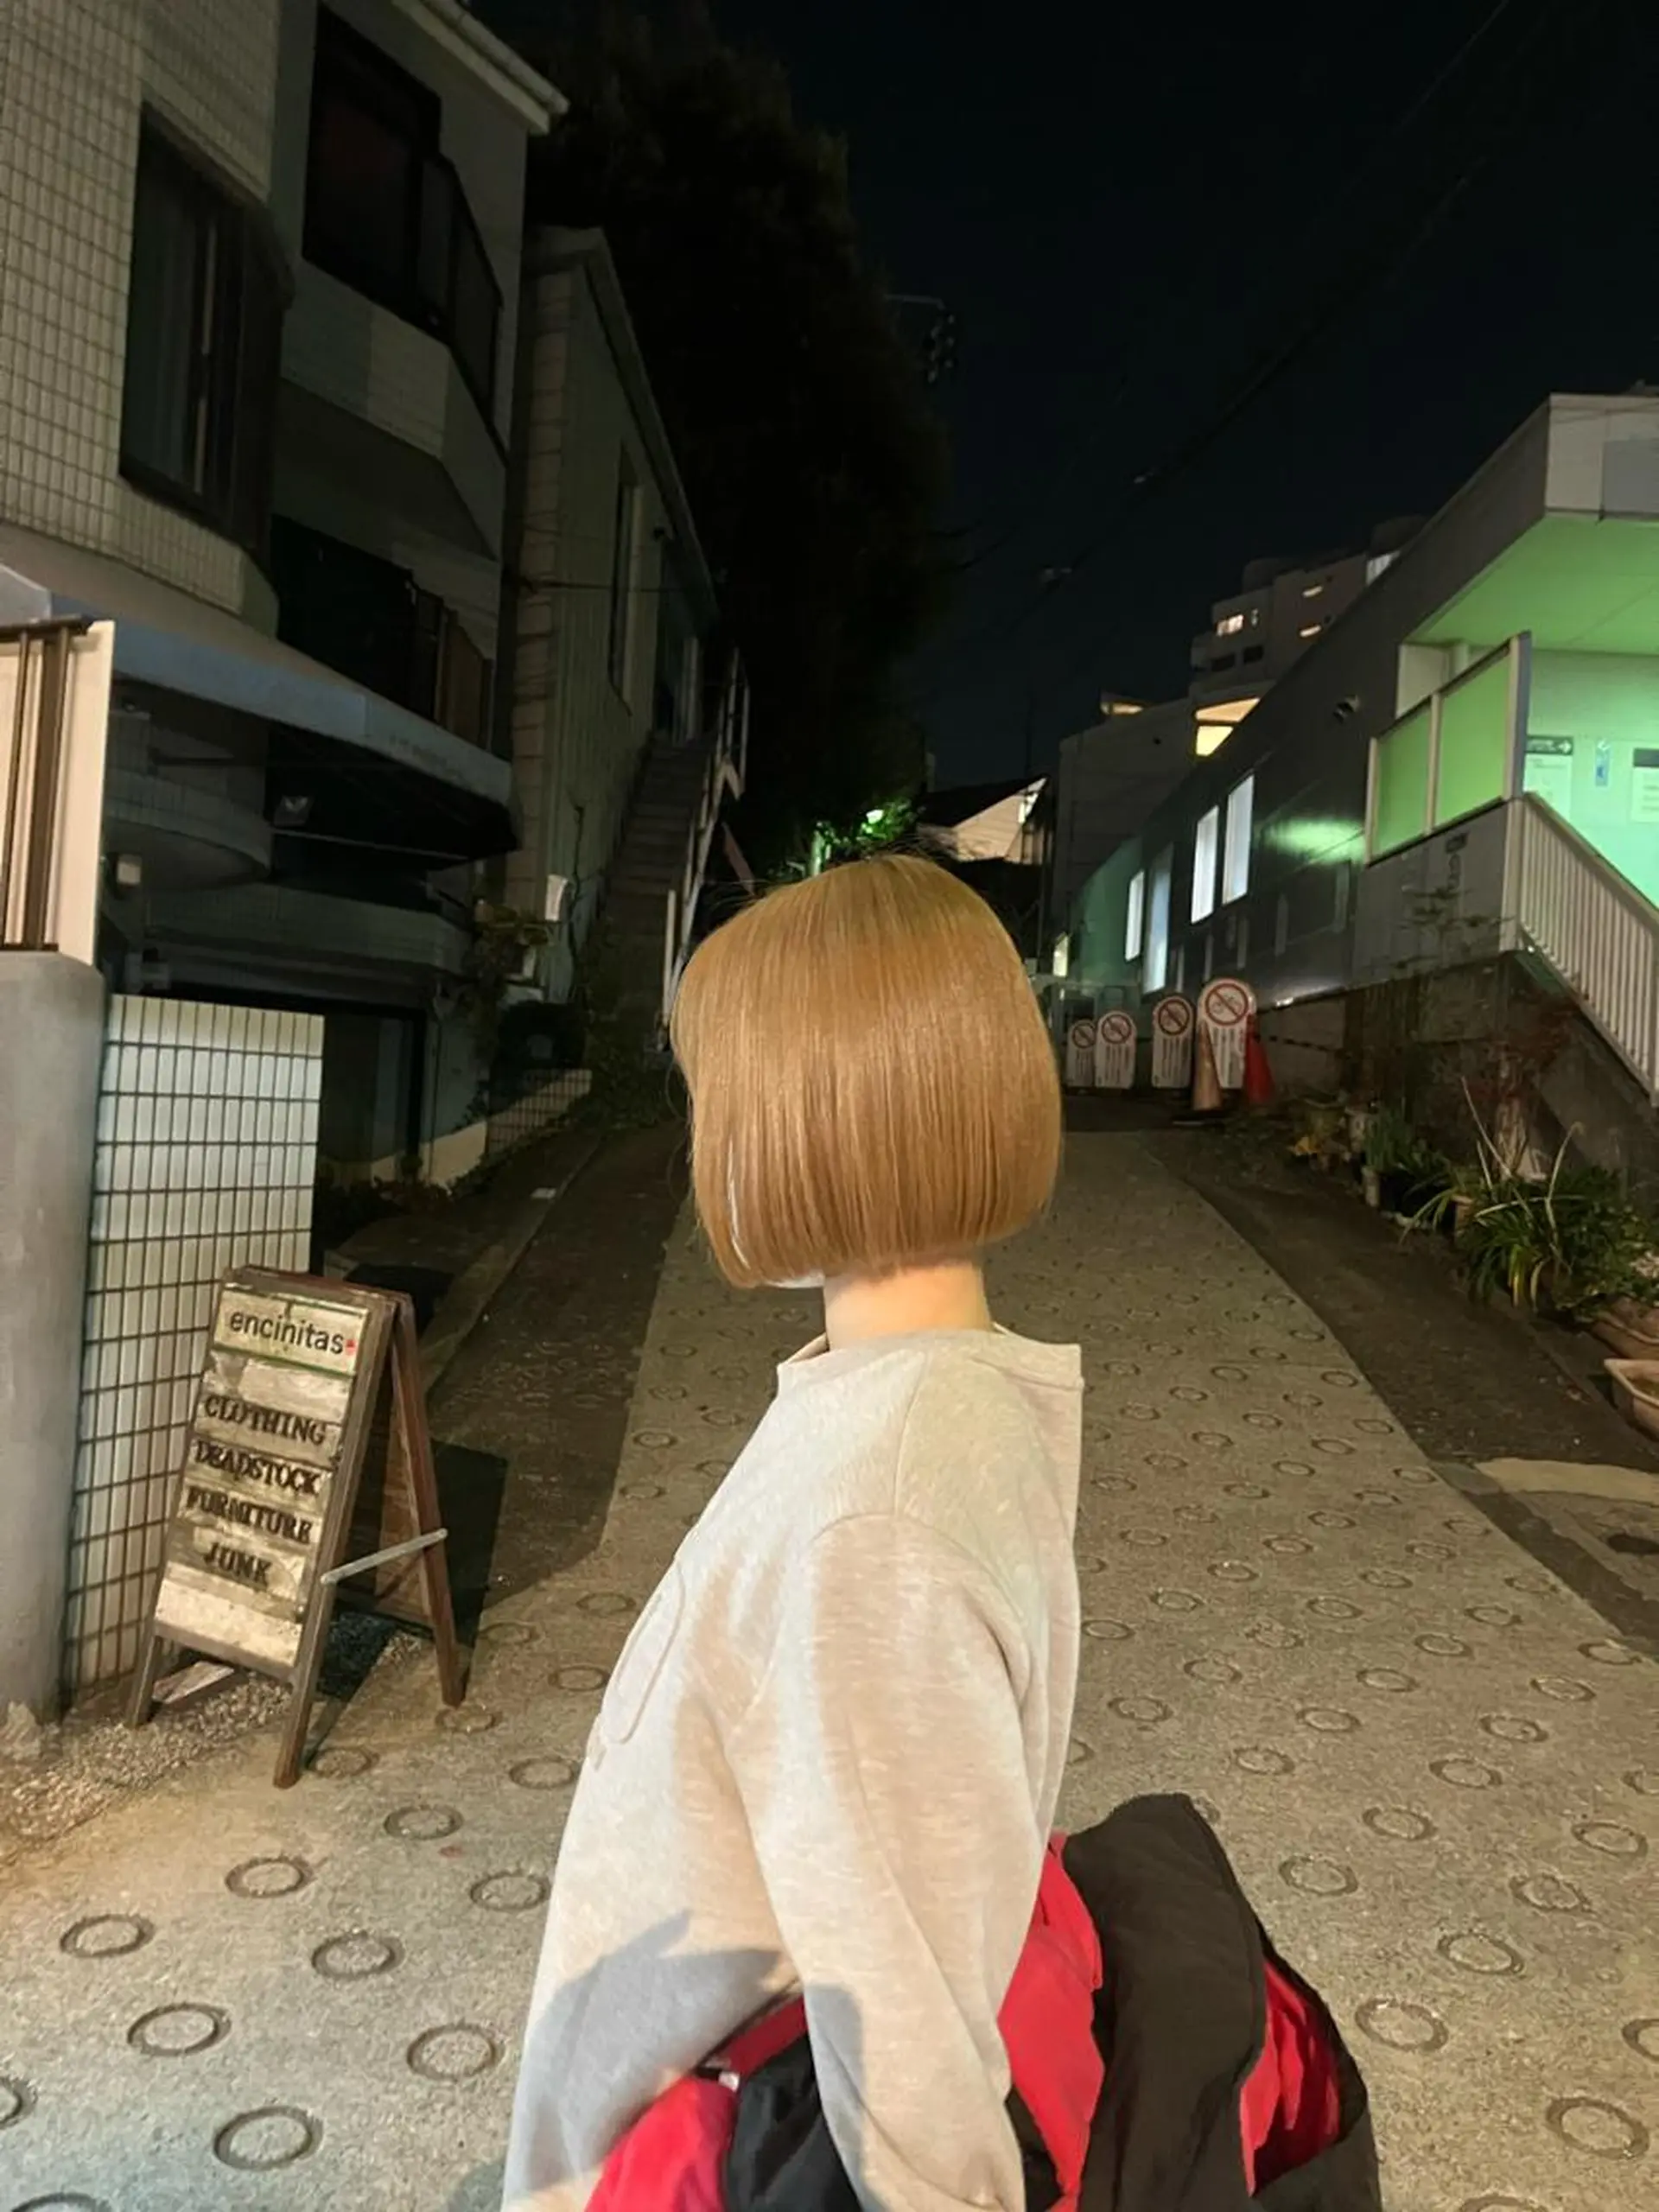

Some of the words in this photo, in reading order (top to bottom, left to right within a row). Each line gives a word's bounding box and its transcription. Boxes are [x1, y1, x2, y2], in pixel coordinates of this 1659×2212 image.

[230, 1309, 344, 1355] encinitas
[204, 1394, 326, 1445] CLOTHING
[195, 1440, 320, 1496] DEADSTOCK
[187, 1486, 312, 1544] FURNITURE
[205, 1543, 271, 1590] JUNK
